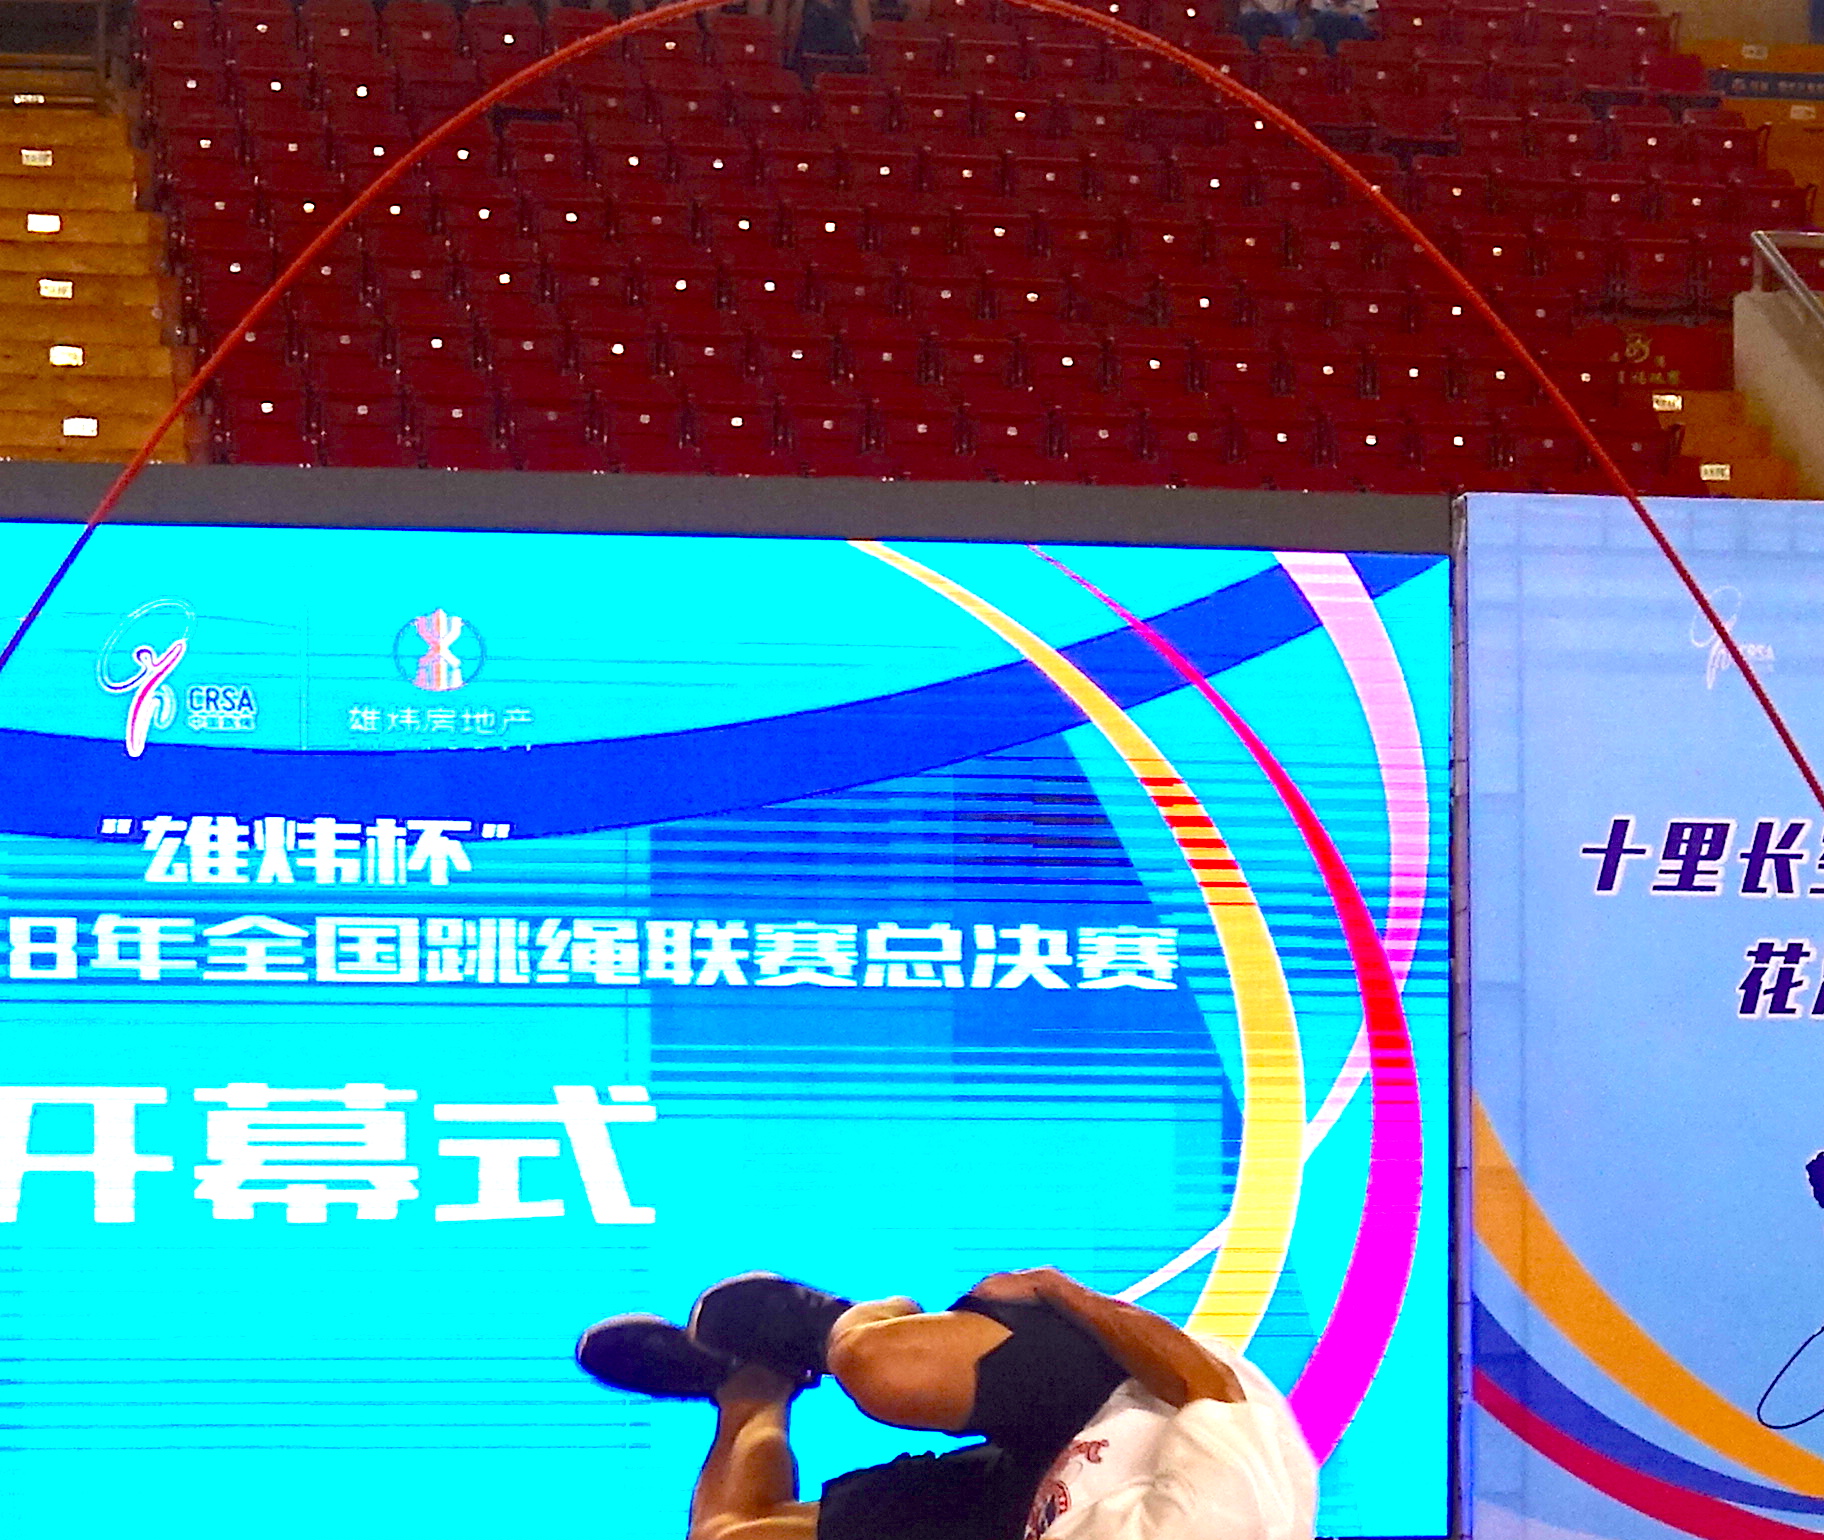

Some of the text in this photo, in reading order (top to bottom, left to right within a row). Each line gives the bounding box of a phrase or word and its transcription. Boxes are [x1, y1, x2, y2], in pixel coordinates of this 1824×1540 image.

[189, 687, 255, 712] CRSA
[348, 706, 534, 736] 雄炜房地产
